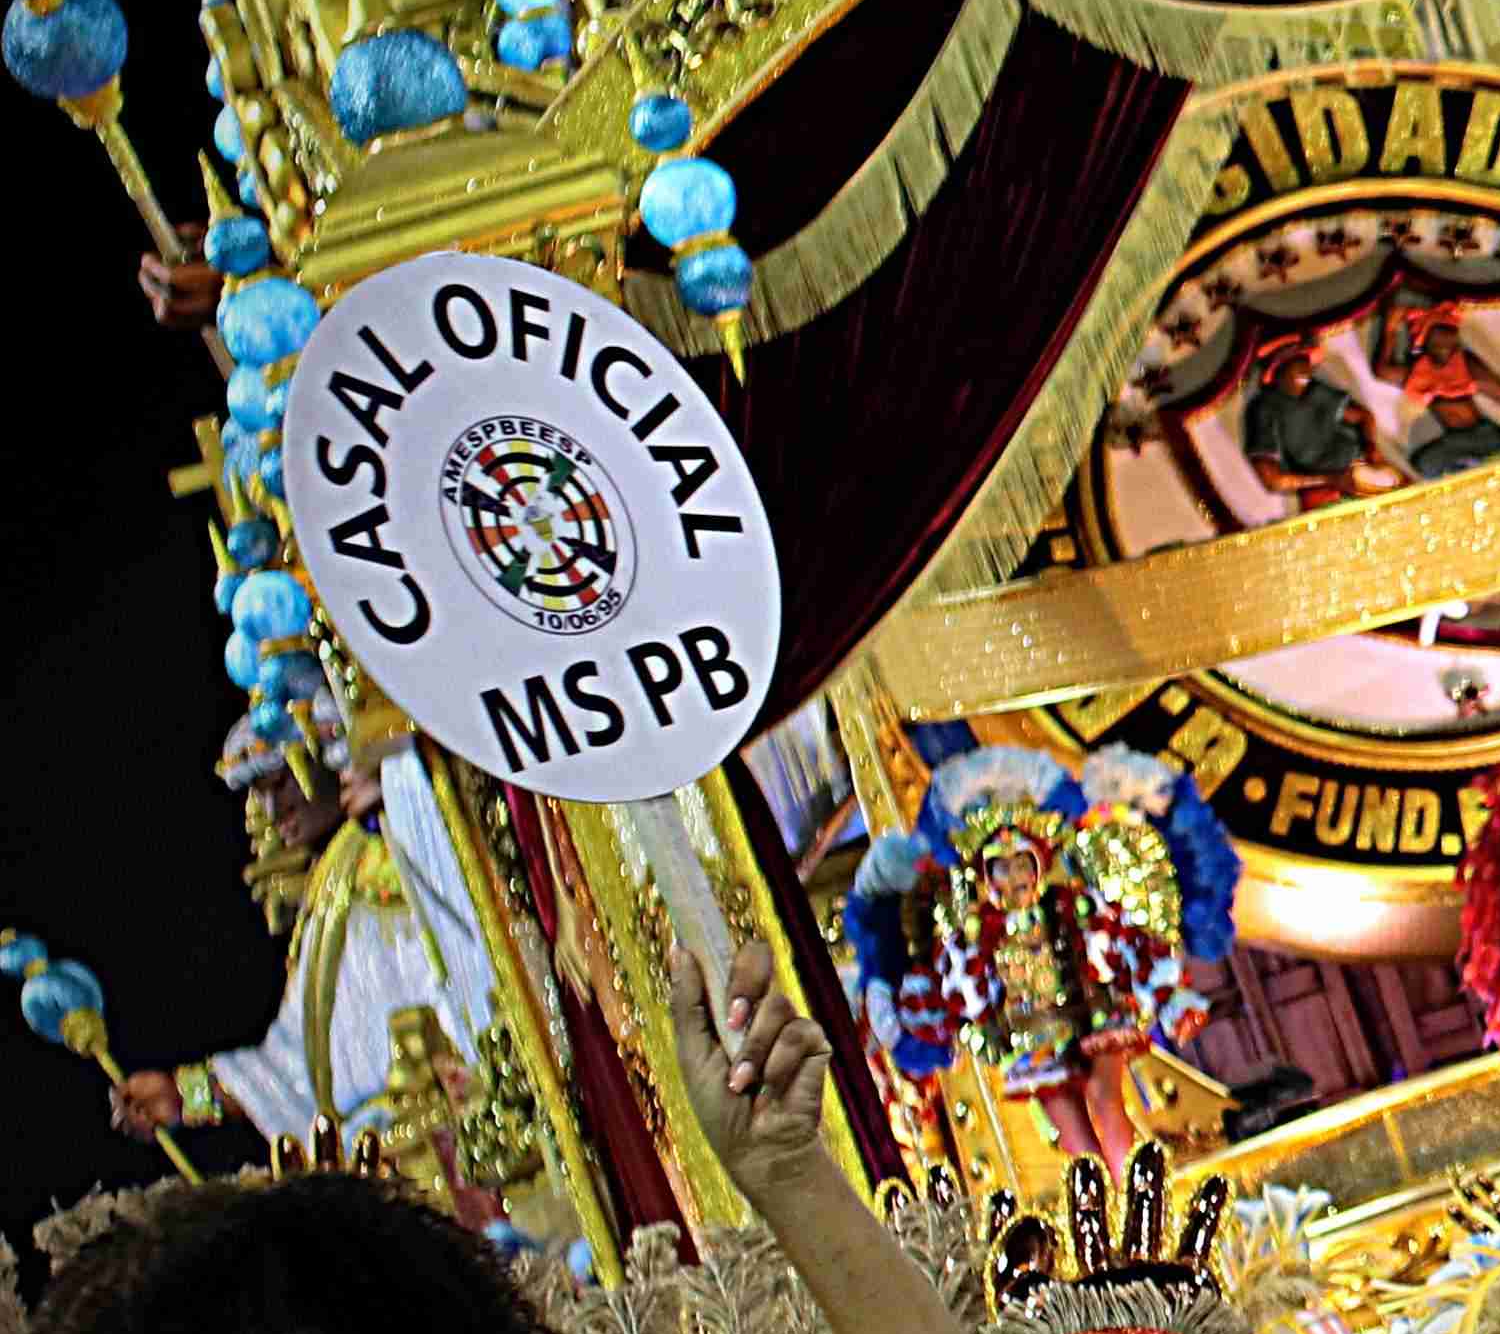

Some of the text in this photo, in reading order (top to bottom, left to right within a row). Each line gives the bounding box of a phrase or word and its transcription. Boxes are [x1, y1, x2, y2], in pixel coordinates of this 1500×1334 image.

[317, 282, 744, 646] CASAL OFICIAL
[443, 419, 592, 505] AMESPBEESP
[533, 587, 622, 631] 10/06/95
[480, 624, 749, 774] MS PB
